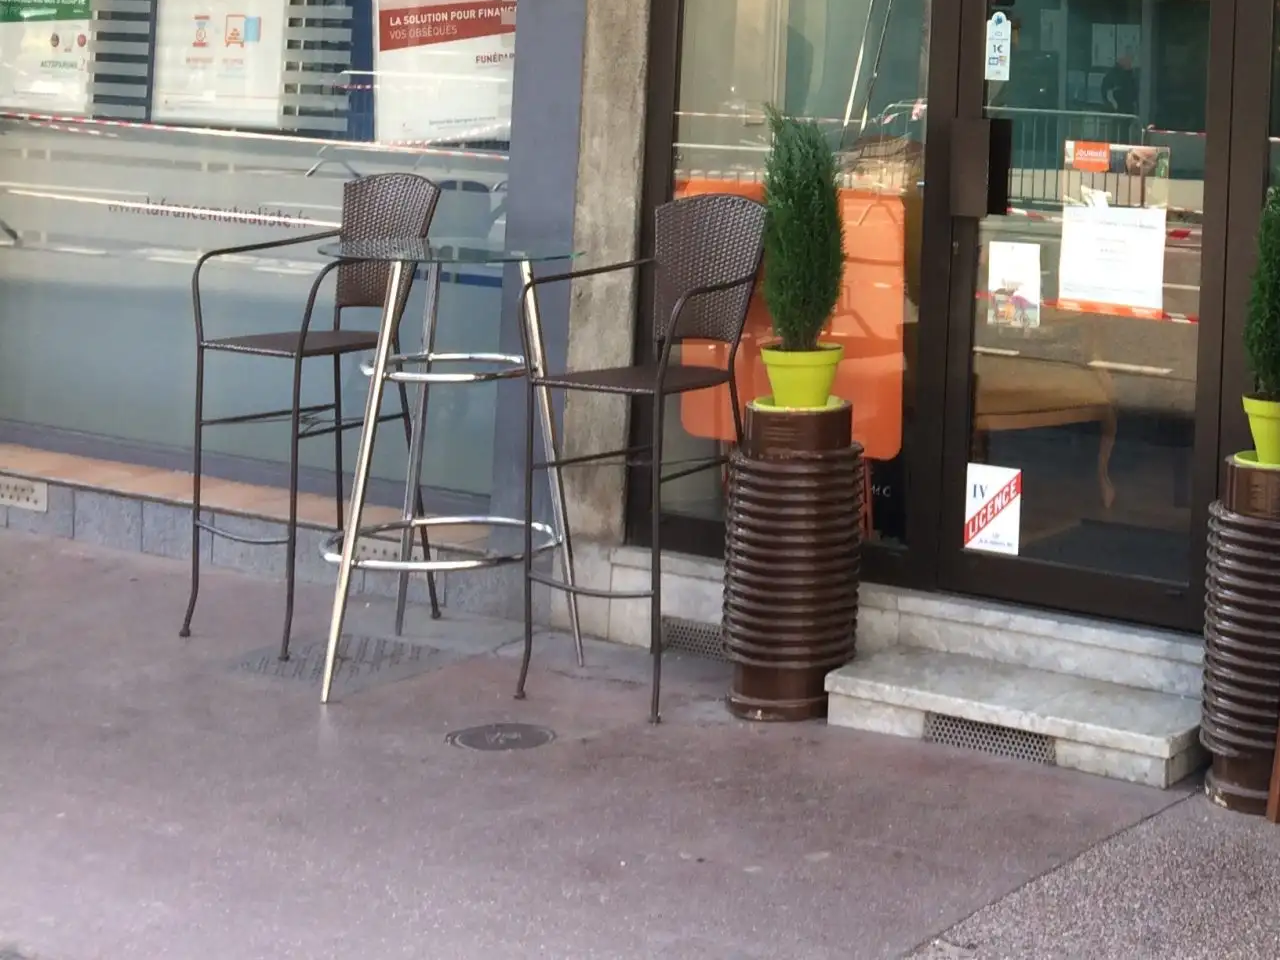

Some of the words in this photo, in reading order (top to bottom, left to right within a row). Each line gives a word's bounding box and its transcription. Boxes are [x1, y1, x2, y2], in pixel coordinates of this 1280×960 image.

[389, 16, 402, 26] LA
[404, 11, 448, 25] SOLUTION
[450, 9, 476, 21] POUR
[389, 28, 407, 40] VOS
[972, 483, 988, 499] IV
[967, 477, 1018, 539] LICENCE
